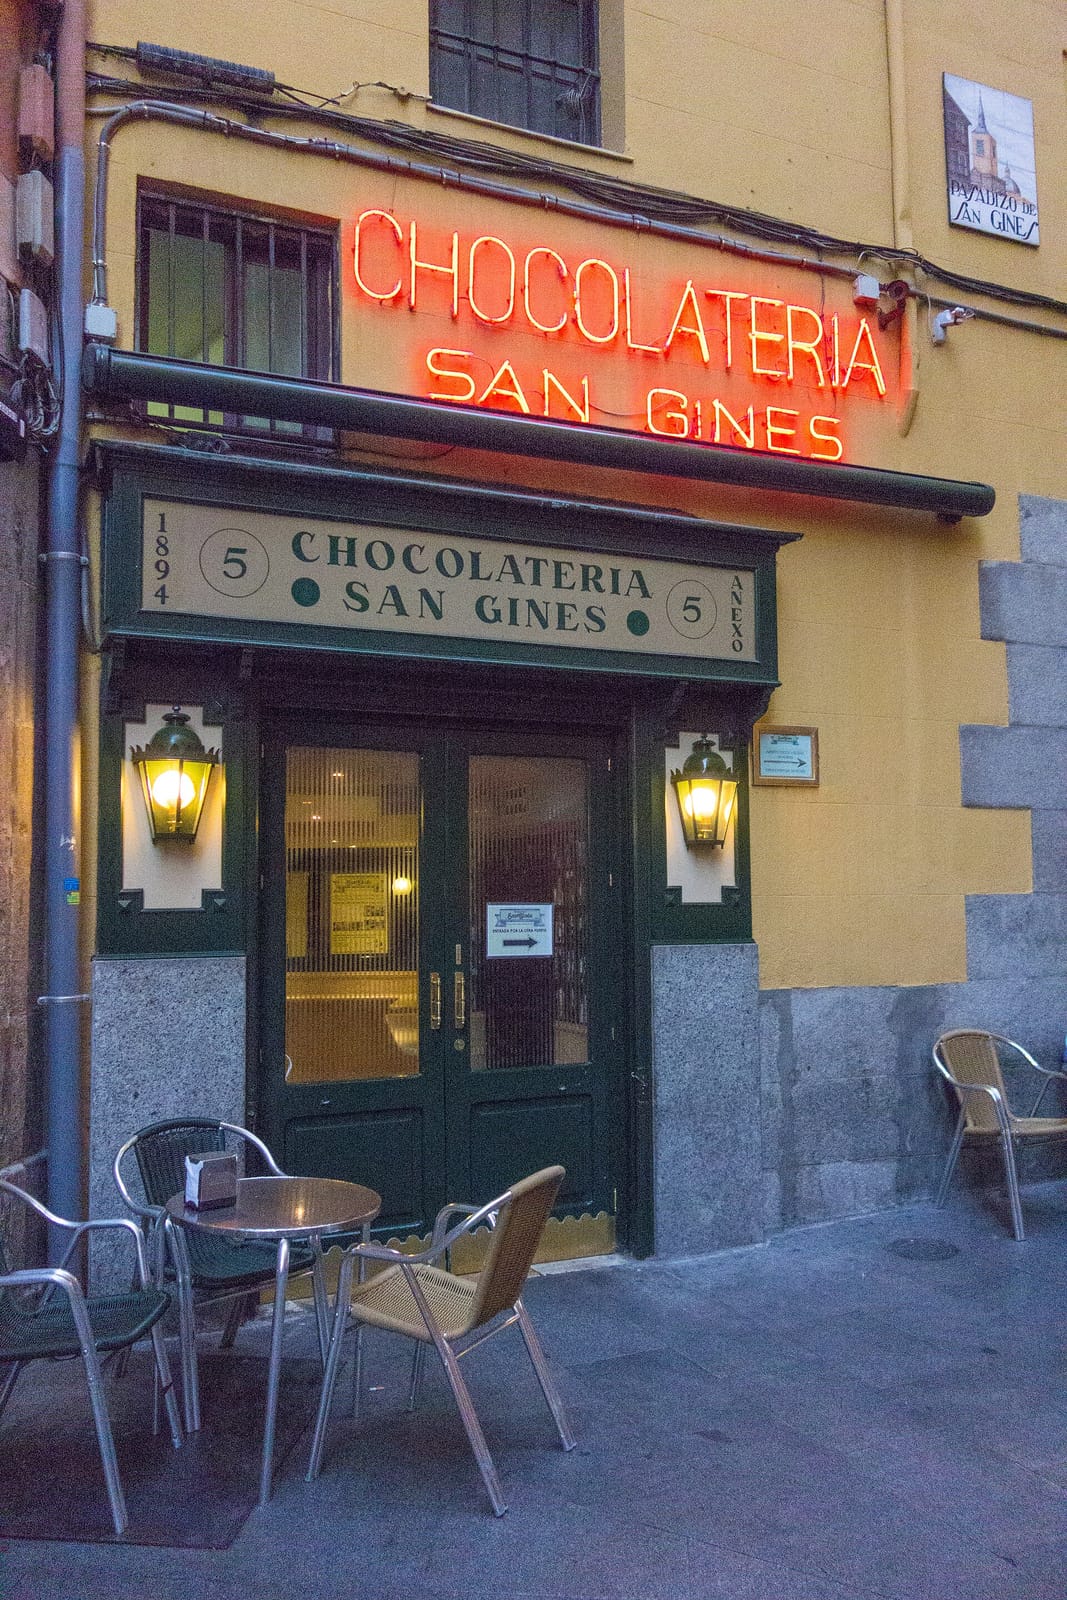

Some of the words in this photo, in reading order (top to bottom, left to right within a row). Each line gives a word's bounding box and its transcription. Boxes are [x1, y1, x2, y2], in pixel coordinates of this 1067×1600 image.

[951, 179, 1018, 213] PASADIZO
[1022, 201, 1037, 217] DE
[952, 201, 981, 224] SAN
[990, 209, 1039, 240] GINES
[353, 209, 887, 396] CHOCOLATERIA
[426, 347, 591, 423] SAN
[646, 388, 843, 461] GINES
[154, 512, 170, 605] 1894
[222, 547, 248, 579] 5
[291, 531, 653, 599] CHOCOLATERIA
[342, 581, 446, 621] SAN
[474, 594, 607, 634] GINES
[682, 596, 702, 623] 5
[730, 575, 744, 653] ANEXO
